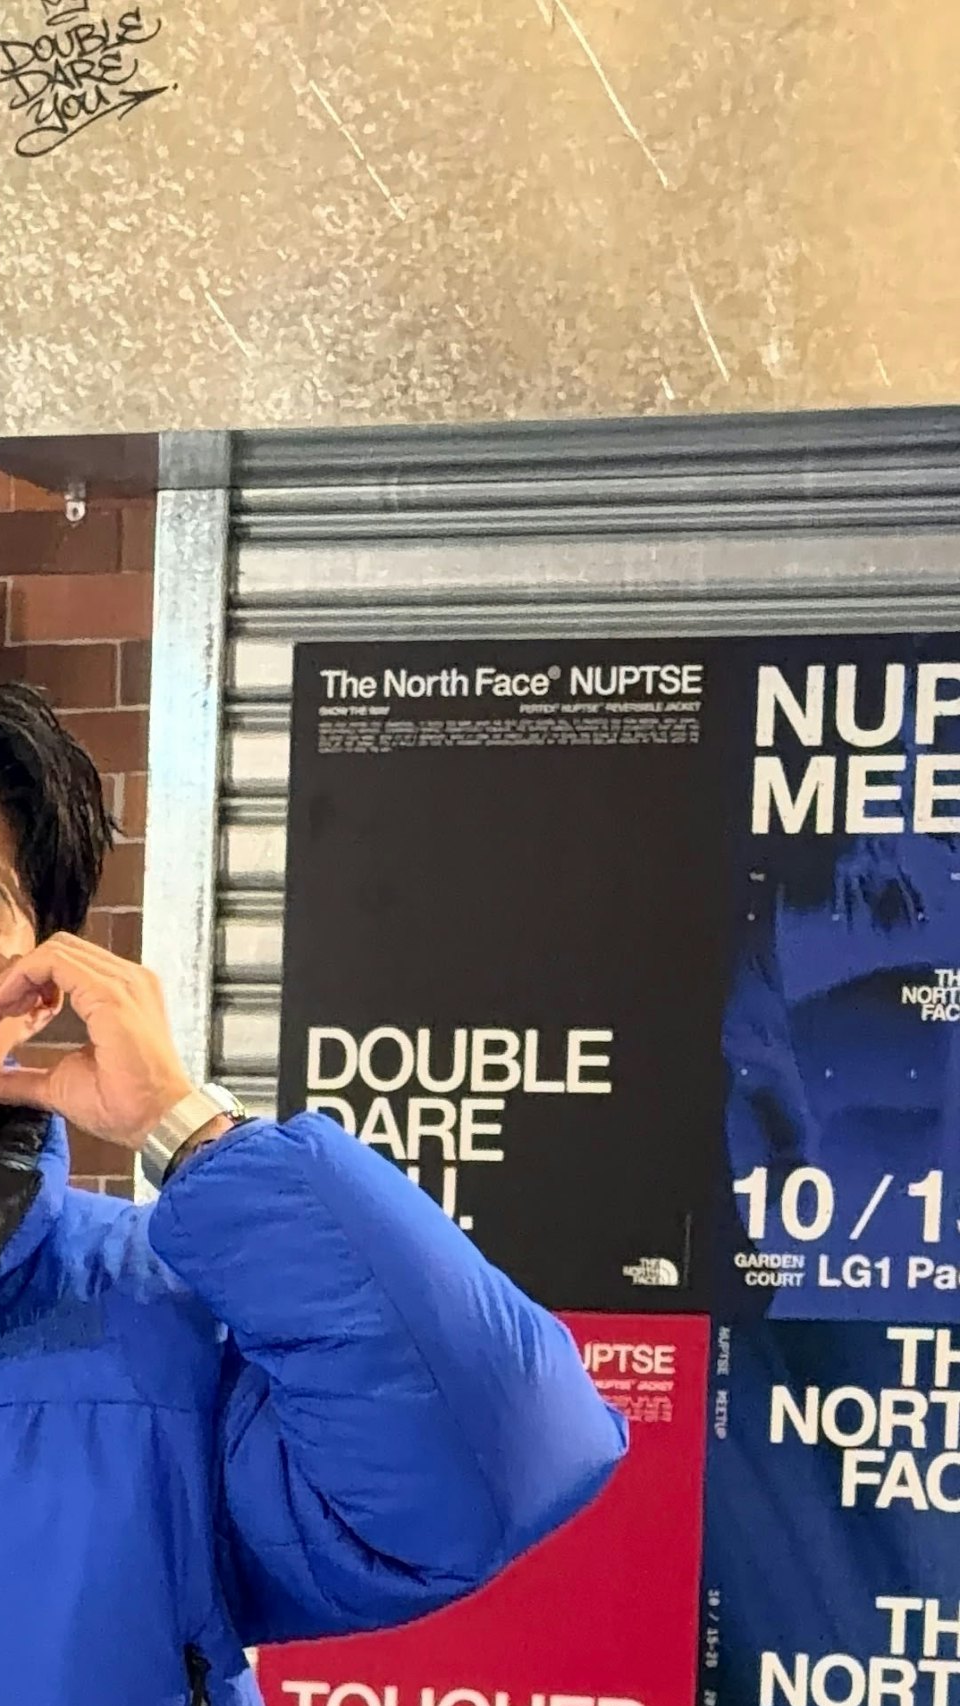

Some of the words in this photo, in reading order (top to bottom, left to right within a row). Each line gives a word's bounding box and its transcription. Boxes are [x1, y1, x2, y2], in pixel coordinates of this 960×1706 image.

[320, 669, 377, 699] The
[384, 667, 469, 698] North
[570, 665, 704, 696] NUPTSE
[751, 754, 960, 835] MEE
[307, 1027, 613, 1094] DOUBLE
[734, 1253, 805, 1269] GARDEN
[818, 1254, 891, 1289] LG1
[907, 1255, 960, 1290] Pa
[745, 1272, 805, 1287] COURT
[584, 1342, 676, 1374] PTSE
[841, 1449, 960, 1513] FAC
